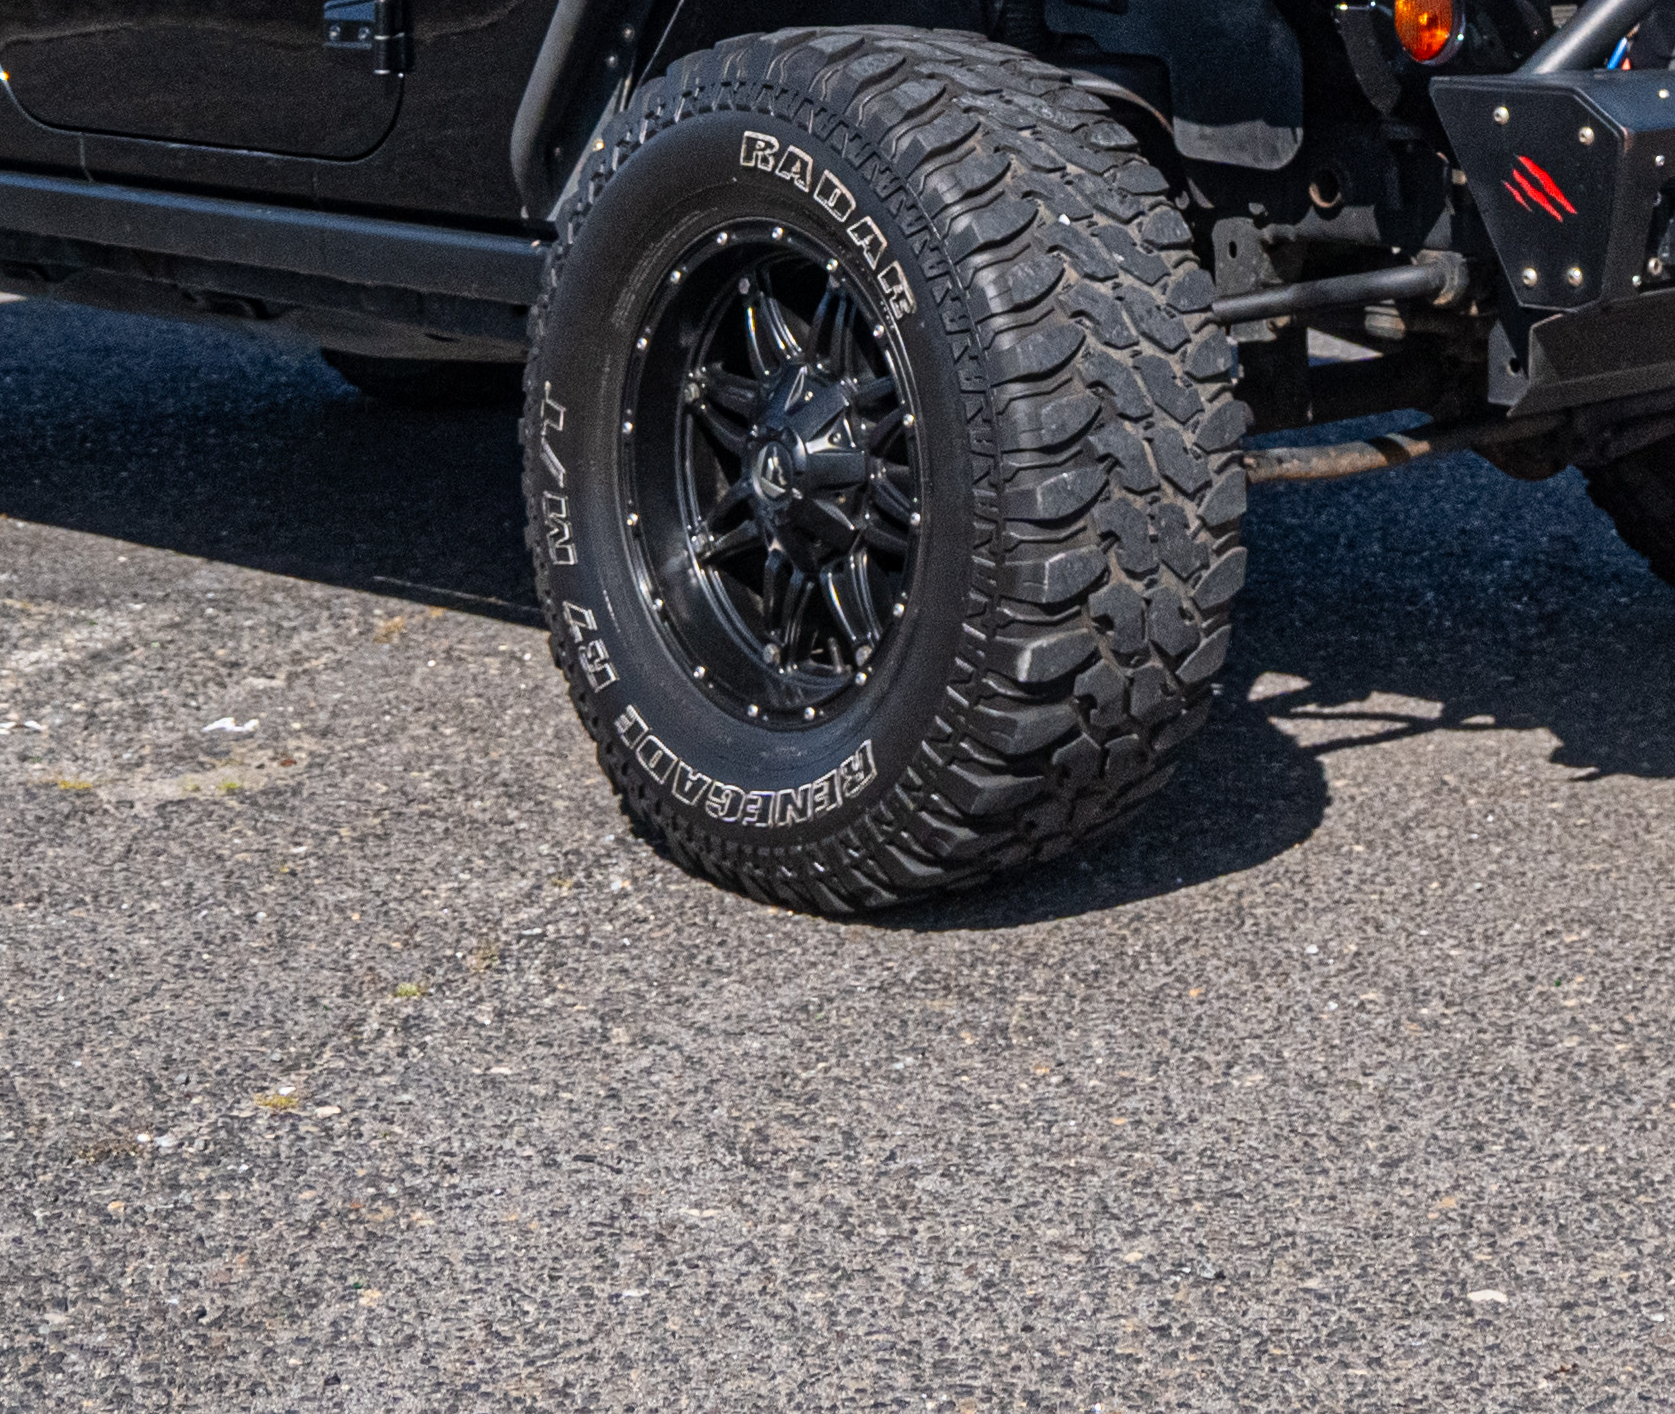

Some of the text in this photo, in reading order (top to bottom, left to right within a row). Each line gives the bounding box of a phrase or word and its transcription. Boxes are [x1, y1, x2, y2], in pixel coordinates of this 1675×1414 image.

[740, 130, 917, 321] RADAR
[540, 380, 878, 828] RENEGADE R7 M/T
